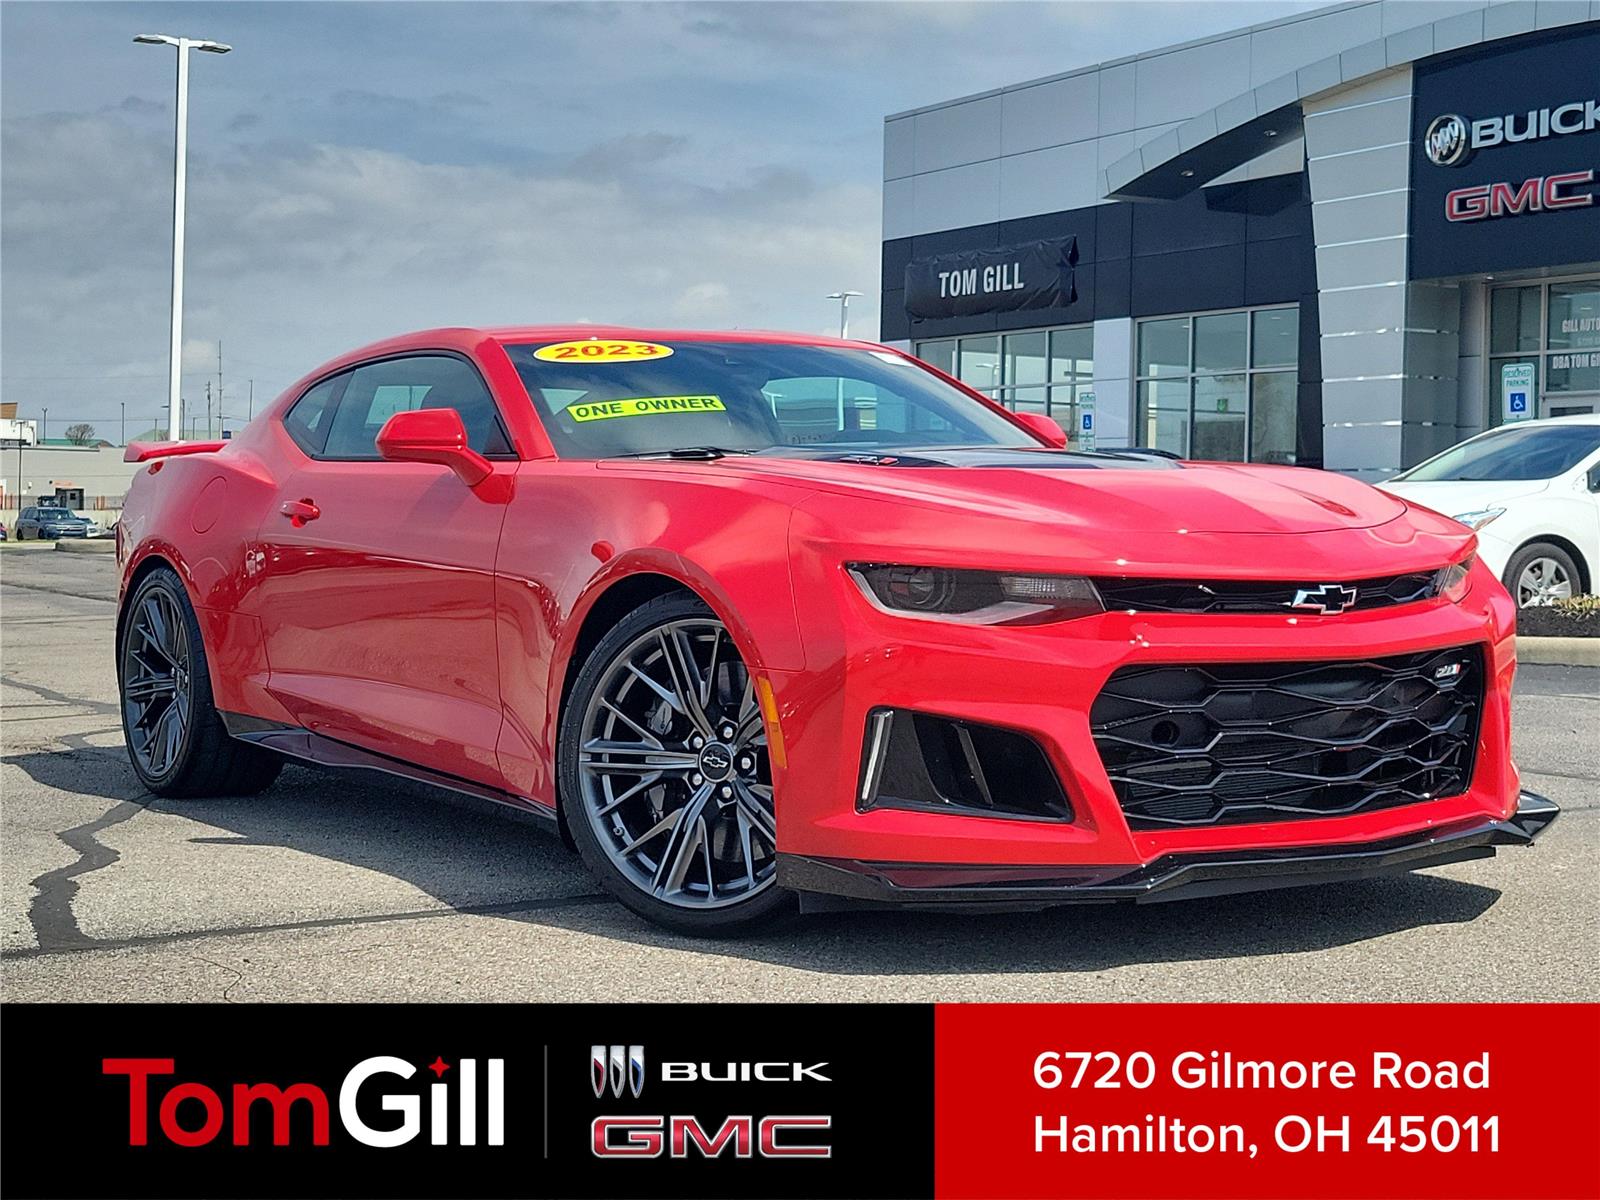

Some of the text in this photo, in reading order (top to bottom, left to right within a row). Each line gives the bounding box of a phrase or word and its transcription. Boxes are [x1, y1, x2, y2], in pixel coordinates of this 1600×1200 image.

[1445, 168, 1594, 222] GMC
[938, 262, 1025, 298] TOM GILL
[554, 344, 659, 359] 2023
[1571, 354, 1590, 368] TOM
[575, 398, 720, 418] ONE OWNER
